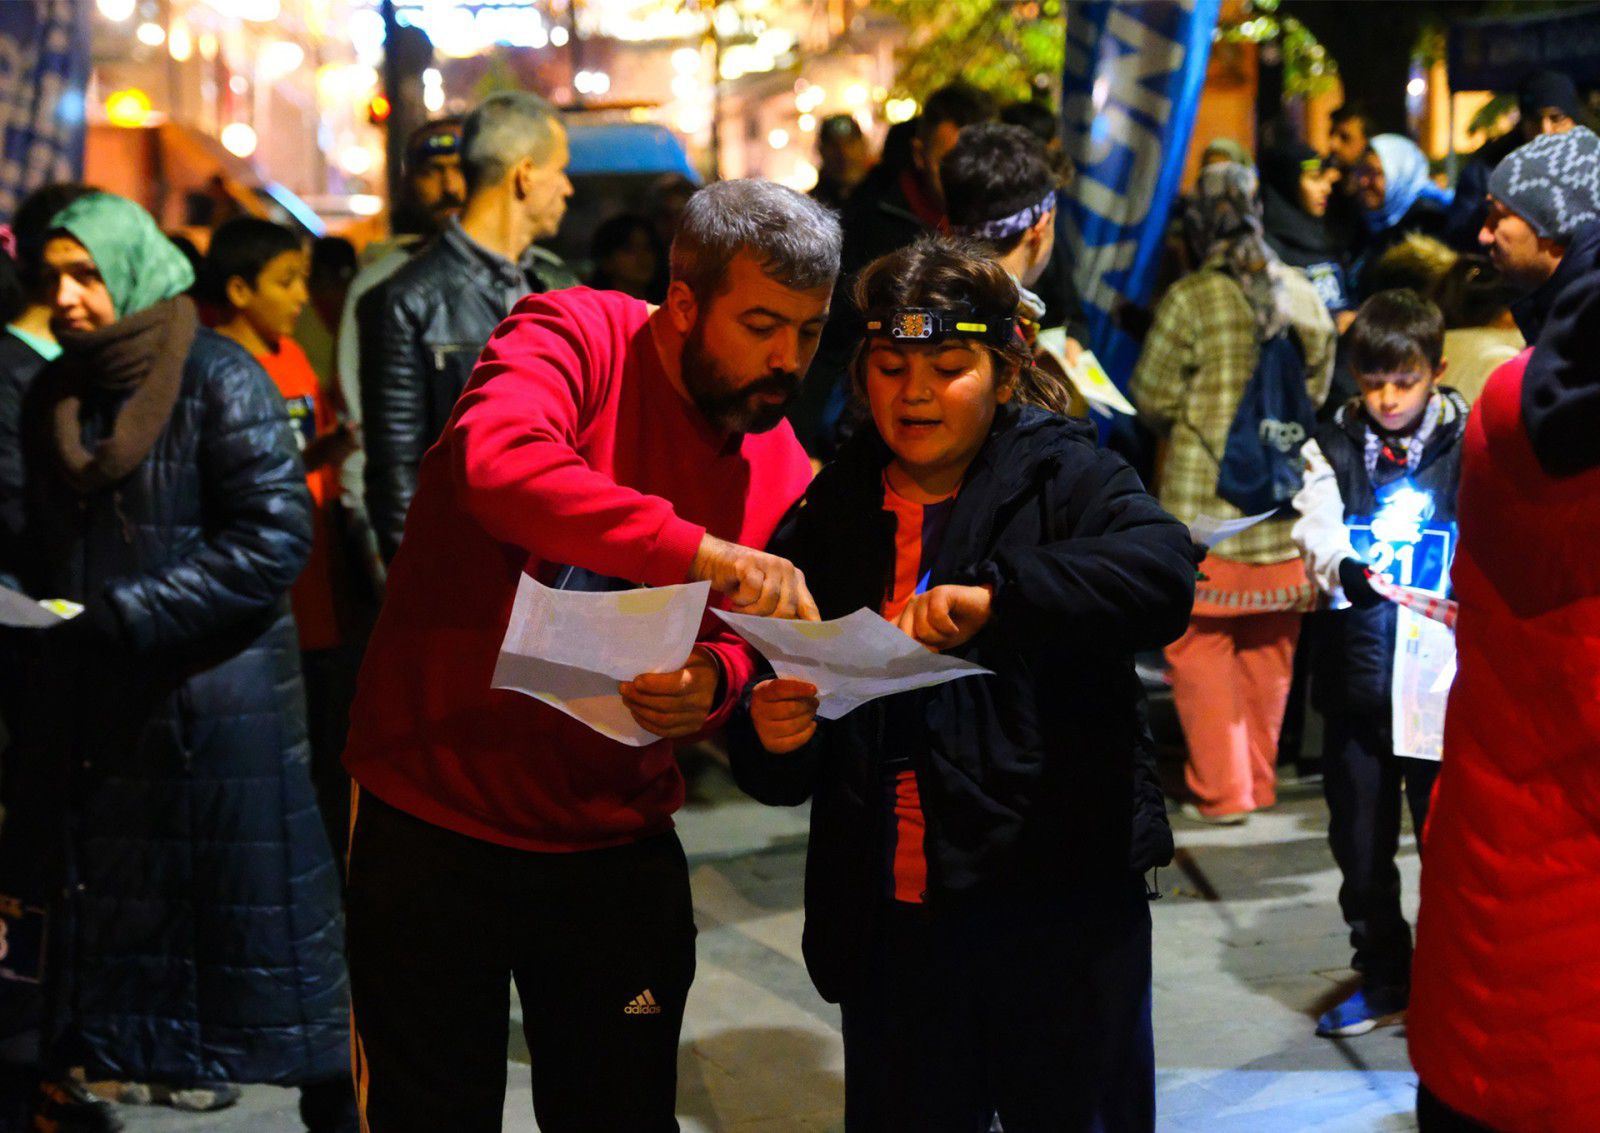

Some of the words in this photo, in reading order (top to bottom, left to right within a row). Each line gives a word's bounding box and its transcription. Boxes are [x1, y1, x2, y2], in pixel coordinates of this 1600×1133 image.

[1064, 0, 1197, 314] KON
[1368, 540, 1414, 585] 21
[624, 1004, 662, 1014] adidas
